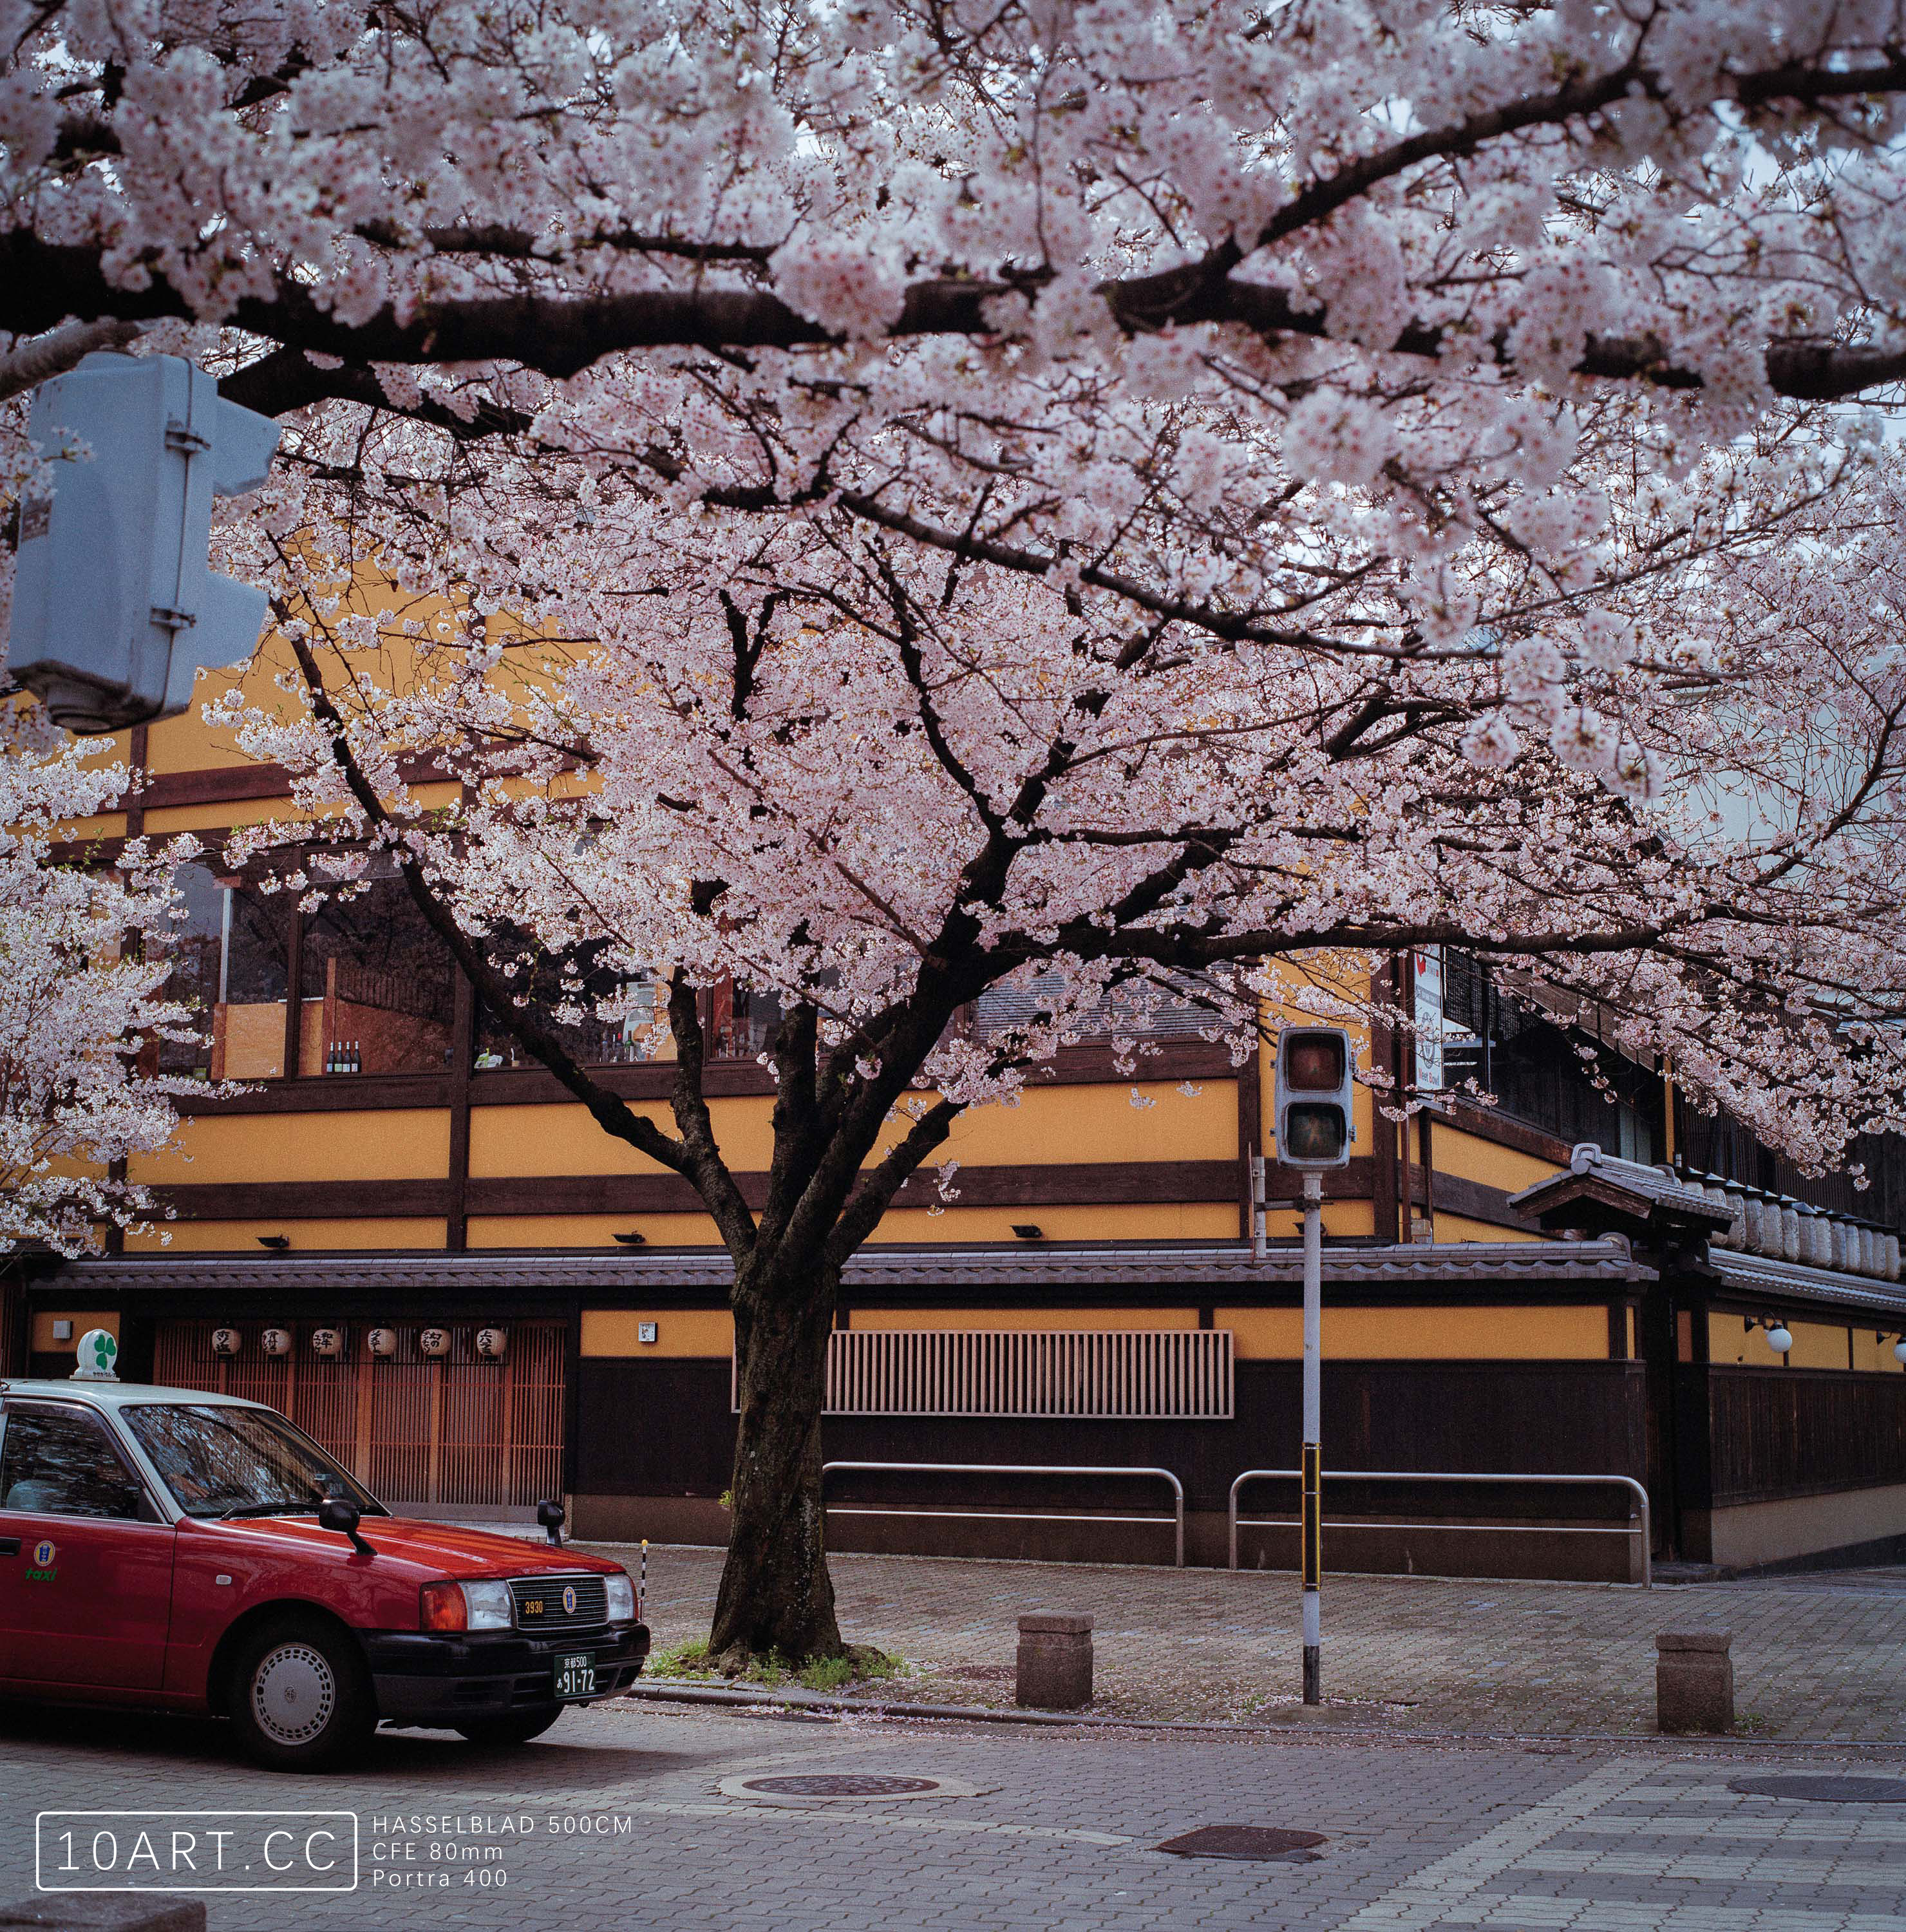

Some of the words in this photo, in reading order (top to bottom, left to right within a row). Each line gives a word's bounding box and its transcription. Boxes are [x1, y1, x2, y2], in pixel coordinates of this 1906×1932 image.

[1418, 1066, 1428, 1083] Meet
[1429, 1072, 1440, 1086] Bowl
[321, 1332, 334, 1349] 和牛
[429, 1332, 442, 1348] 幻の
[26, 1567, 57, 1582] taxi
[525, 1600, 543, 1614] 3930
[563, 1669, 595, 1693] 91-72
